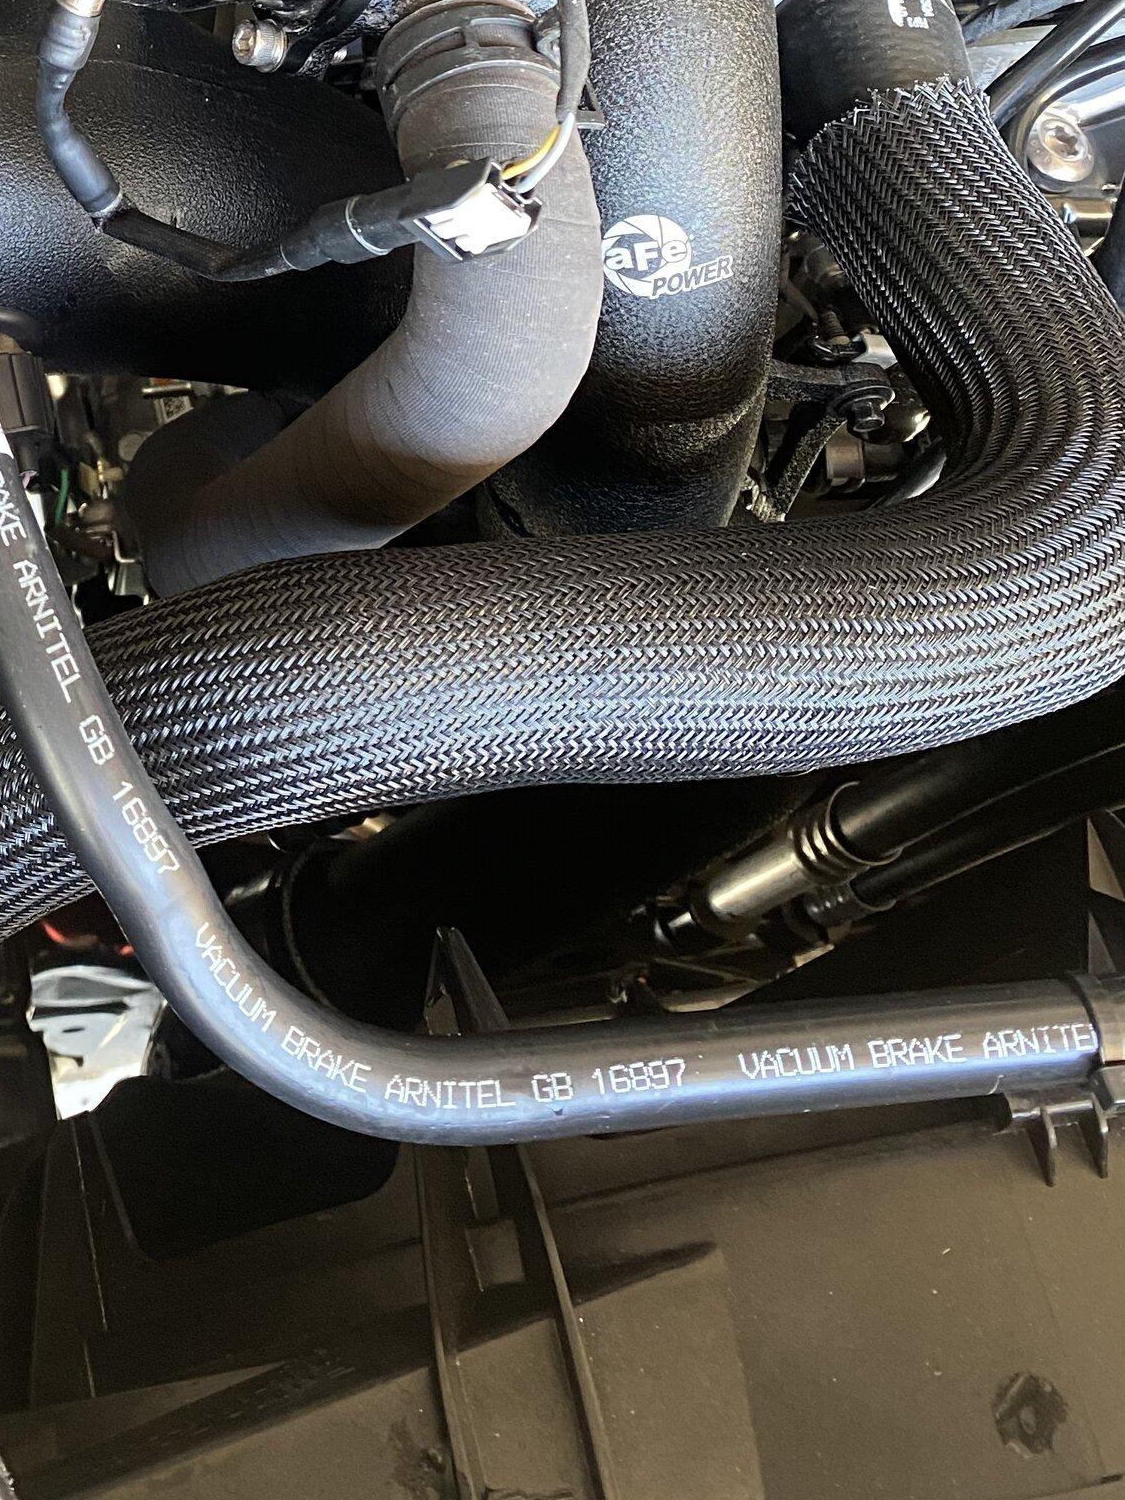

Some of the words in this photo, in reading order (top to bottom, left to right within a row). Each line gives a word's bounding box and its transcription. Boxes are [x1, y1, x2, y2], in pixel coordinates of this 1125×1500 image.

[651, 256, 733, 298] POWER
[13, 559, 81, 704] ARNITEL
[79, 714, 115, 766] GB
[112, 780, 180, 875] 16897
[194, 922, 277, 1033] VACUUM
[280, 1025, 373, 1094] BRAKE
[383, 1072, 516, 1109] ARNITEL
[531, 1072, 575, 1103] GB
[591, 1058, 686, 1097] 16897
[737, 1042, 856, 1080] VACUUM
[867, 1033, 968, 1069] BRAKE
